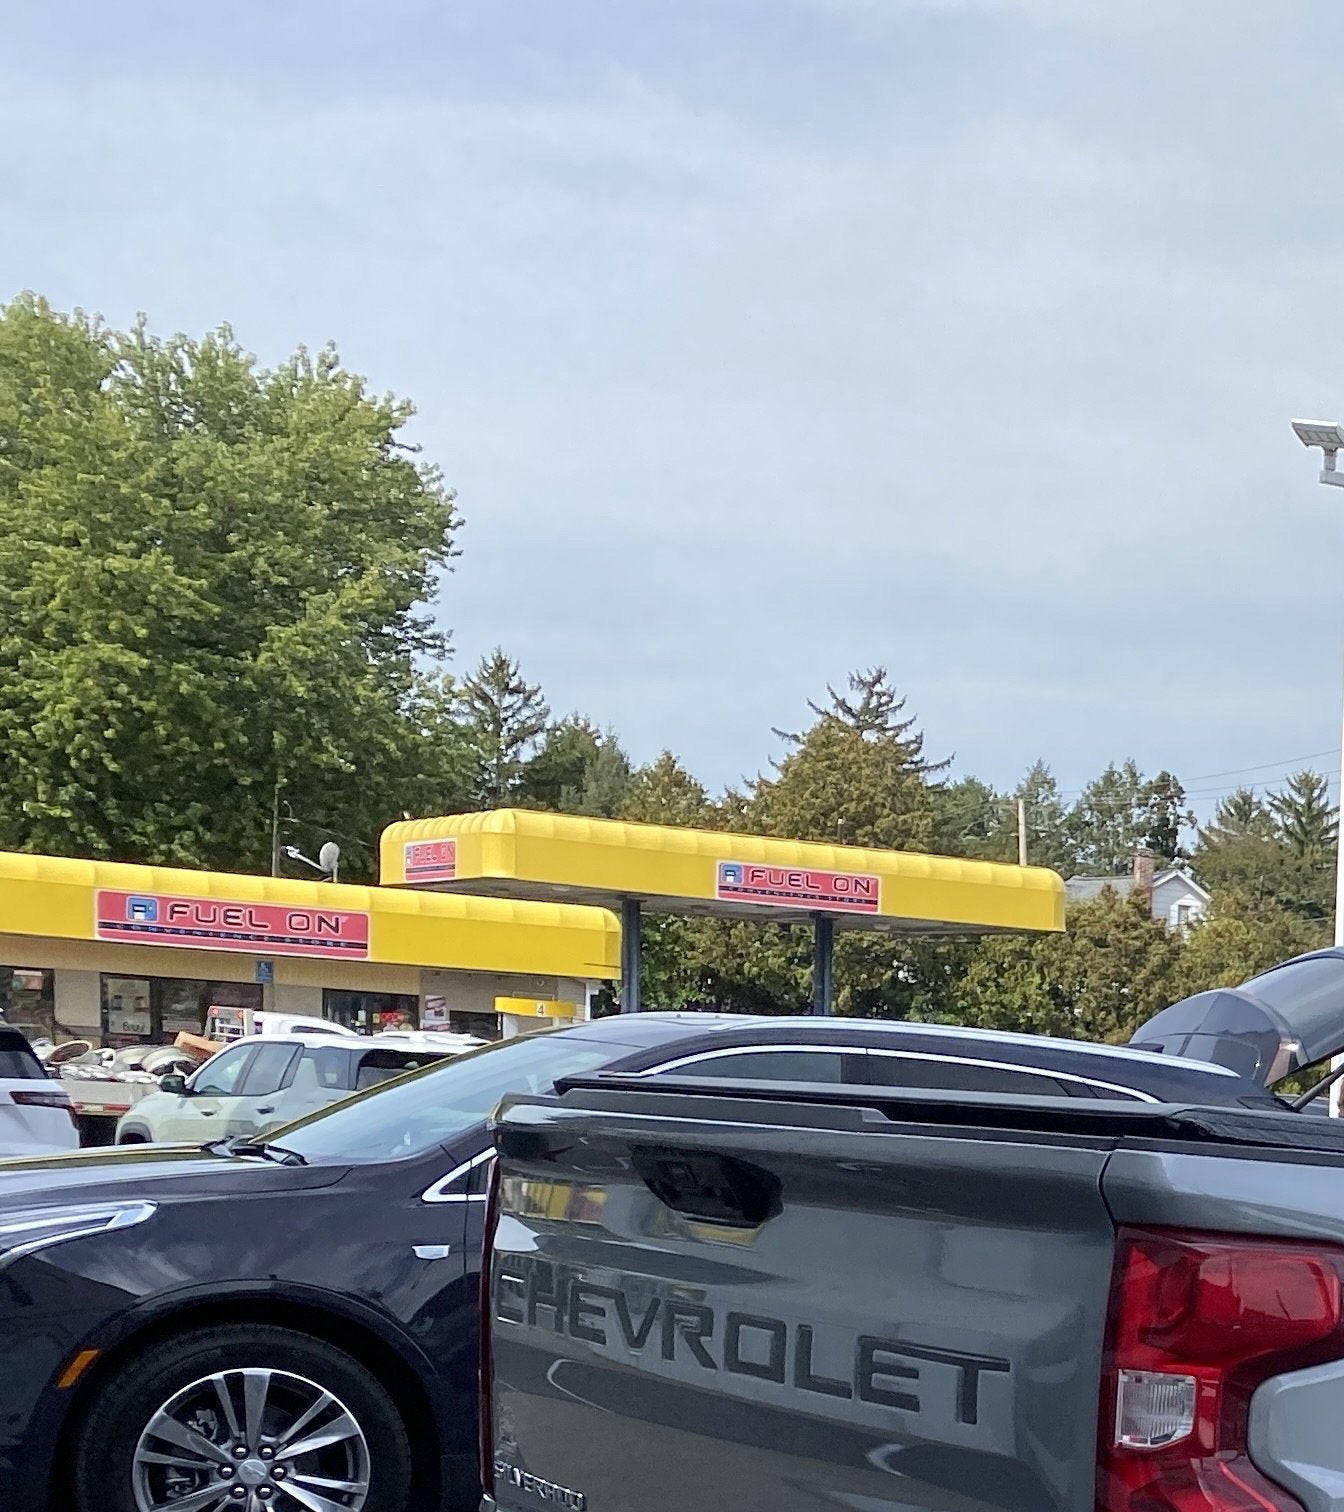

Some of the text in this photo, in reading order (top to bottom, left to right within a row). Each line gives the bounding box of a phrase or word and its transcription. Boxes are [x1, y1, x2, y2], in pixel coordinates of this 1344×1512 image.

[750, 869, 871, 895] FUEL ON
[167, 902, 341, 935] FUEL ON
[537, 1003, 545, 1017] 4
[496, 1264, 1011, 1425] CHEVROLET
